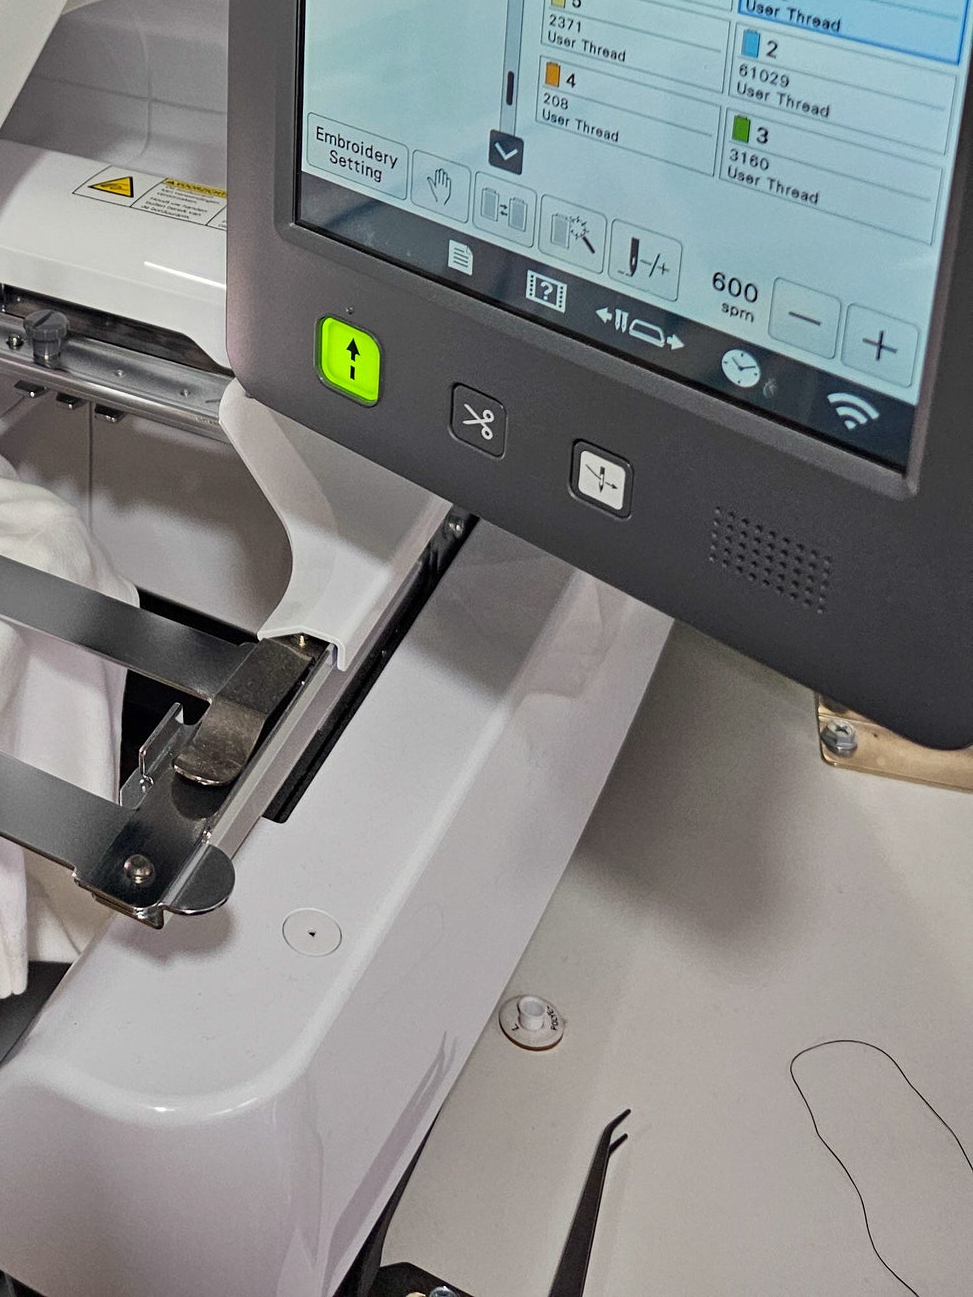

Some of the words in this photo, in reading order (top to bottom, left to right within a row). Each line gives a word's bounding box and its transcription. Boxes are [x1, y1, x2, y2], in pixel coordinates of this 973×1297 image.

[549, 14, 583, 34] 2371
[788, 6, 842, 33] Thread
[547, 31, 578, 50] User
[581, 38, 626, 63] Thread
[765, 41, 779, 59] 2
[565, 72, 577, 89] 4
[738, 64, 790, 88] 61029
[543, 92, 569, 111] 208
[736, 82, 774, 102] User
[778, 91, 831, 119] Thread
[541, 109, 571, 128] User
[574, 117, 620, 144] Thread
[755, 127, 769, 145] 3
[316, 126, 398, 169] Embroidery
[729, 148, 770, 171] 3160
[329, 149, 382, 183] Setting
[727, 165, 764, 187] User
[768, 176, 820, 205] Thread
[712, 271, 759, 303] 600
[721, 302, 755, 323] spm
